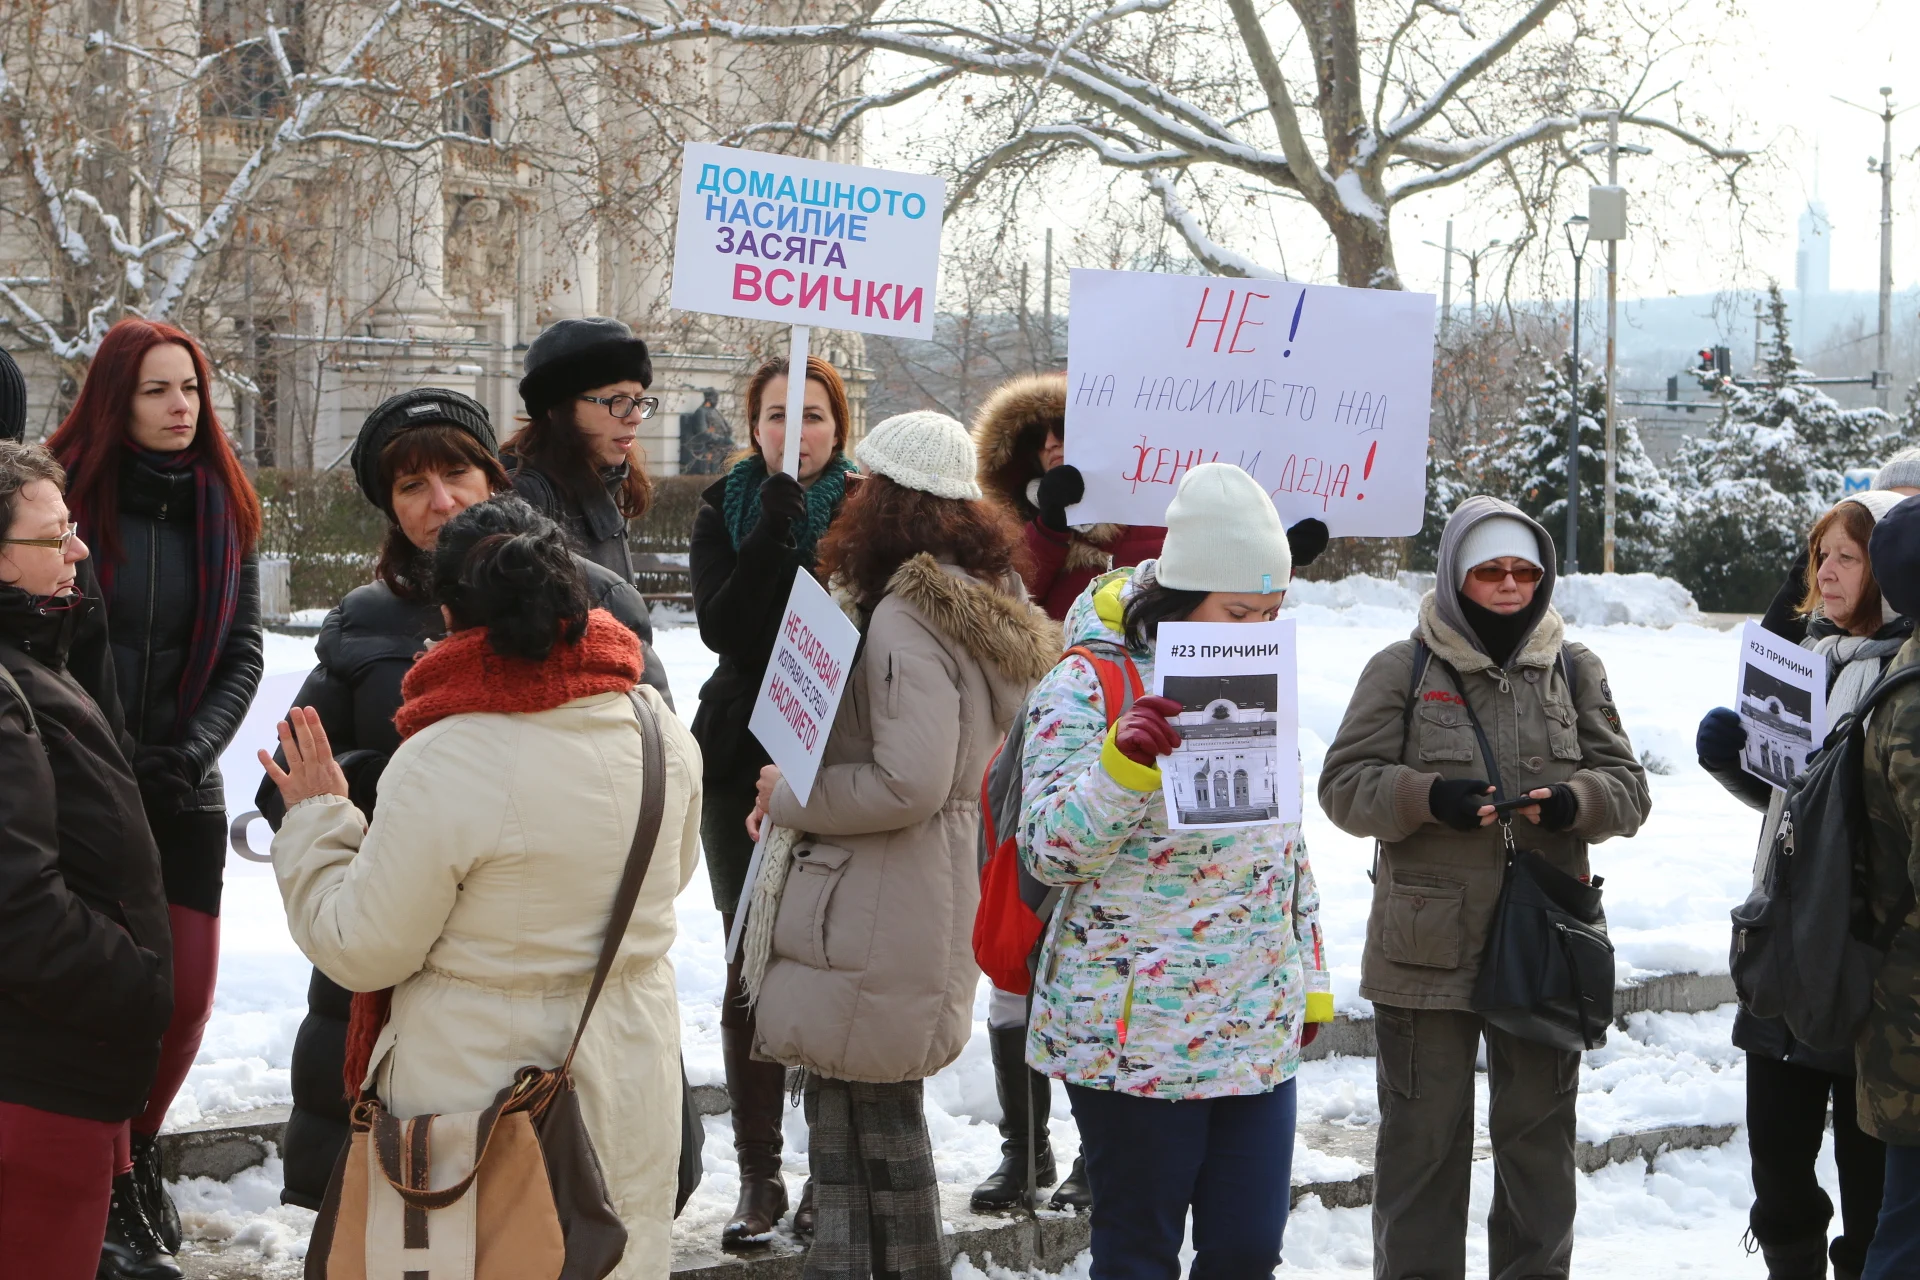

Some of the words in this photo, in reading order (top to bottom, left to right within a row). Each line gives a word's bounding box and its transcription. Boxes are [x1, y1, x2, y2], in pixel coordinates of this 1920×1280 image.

[696, 163, 926, 220] ДОМАШНОТО
[705, 194, 868, 242] НАСИЛИЕ
[715, 226, 847, 269] ЗАСЯГА
[732, 263, 923, 324] ВСИЧКИ
[1075, 372, 1116, 407] НА
[1134, 376, 1317, 422] НАСИЛИЕТО
[1334, 390, 1388, 435] НАД
[1270, 440, 1377, 512] ДЕЦА!
[784, 610, 801, 644] НЕ
[798, 625, 841, 696] СКАТАВАЙ!
[1171, 644, 1196, 658] #23
[1201, 643, 1279, 658] ПРИЧИНИ
[1750, 640, 1765, 656] #23
[1766, 649, 1813, 678] ПРИЧИНИ
[768, 672, 819, 755] НАСИЛИЕТО!
[778, 645, 804, 688] ИЗПРАВИ
[801, 675, 812, 697] СЕ
[809, 686, 829, 721] СРЕЩУ
